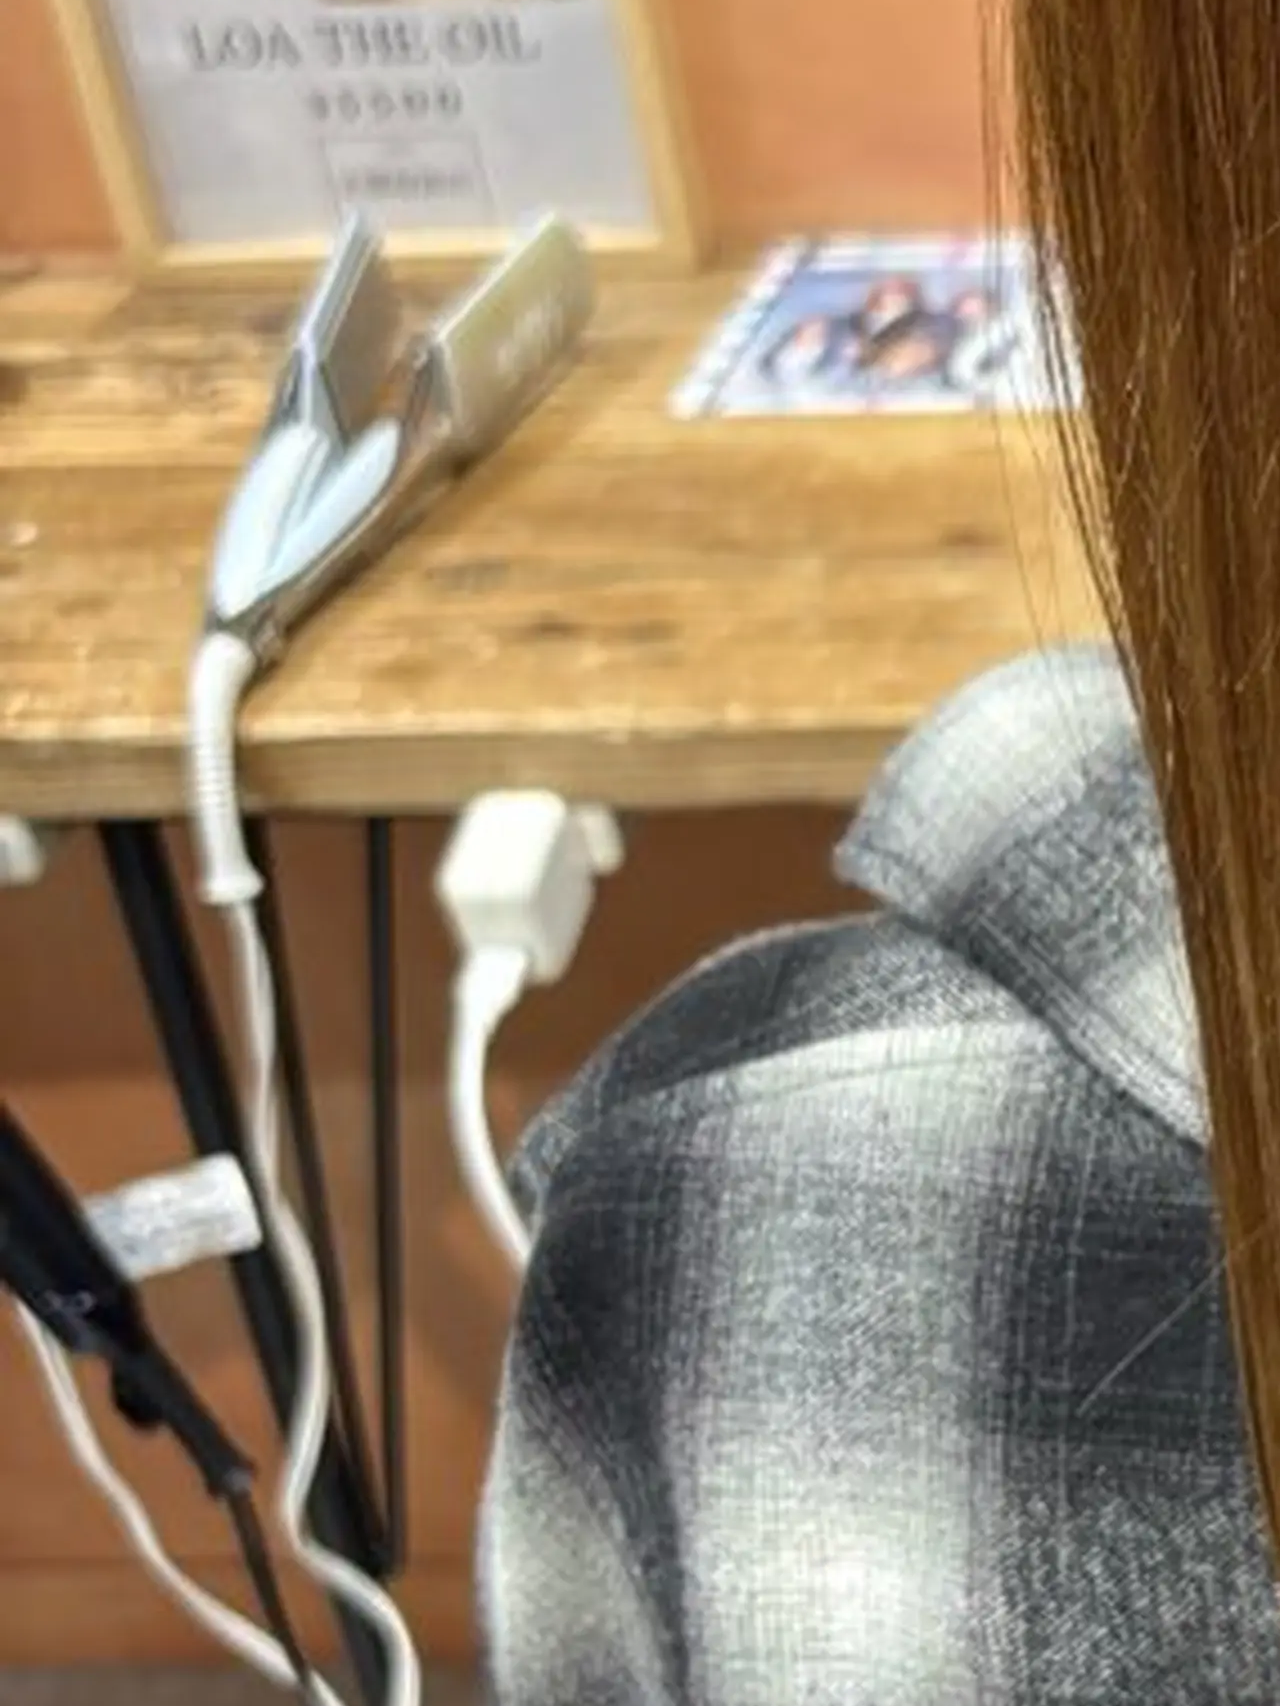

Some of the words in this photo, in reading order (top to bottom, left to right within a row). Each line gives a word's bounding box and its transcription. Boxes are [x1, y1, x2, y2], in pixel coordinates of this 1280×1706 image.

[181, 12, 302, 71] LOA
[312, 10, 430, 67] THE
[437, 7, 541, 65] OIL
